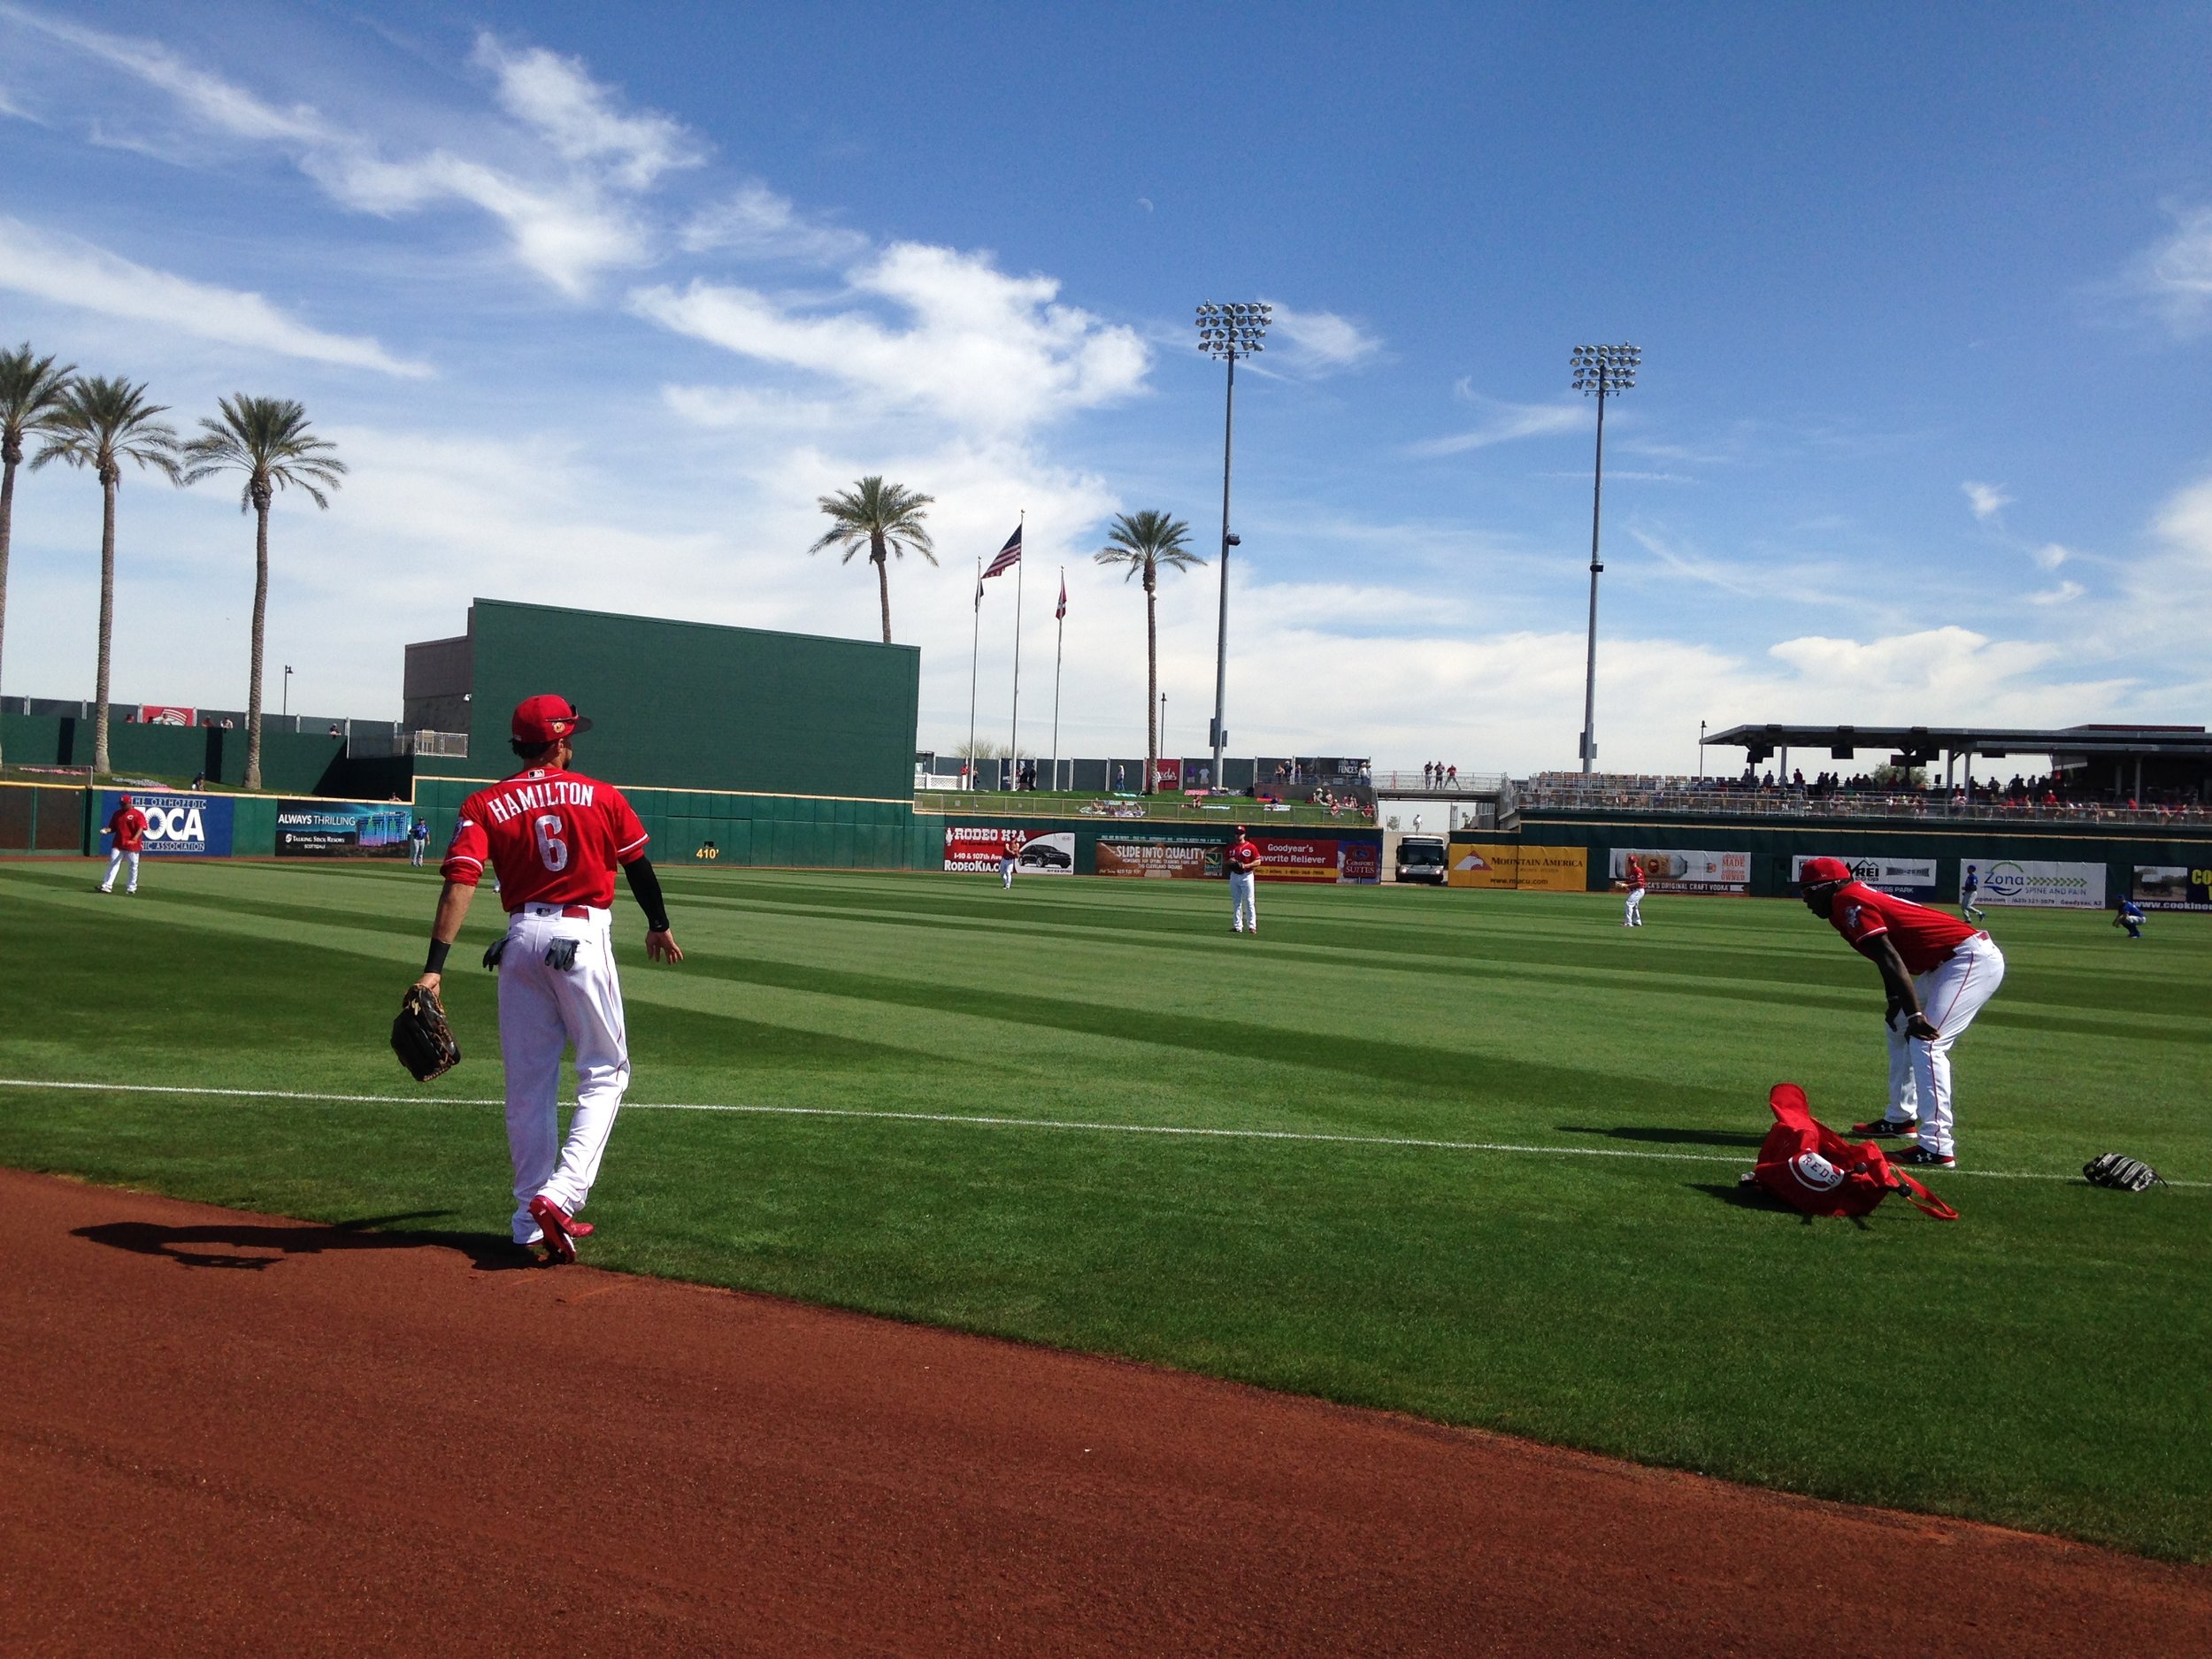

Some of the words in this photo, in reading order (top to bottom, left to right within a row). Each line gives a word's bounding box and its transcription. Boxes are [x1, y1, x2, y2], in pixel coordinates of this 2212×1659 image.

[151, 798, 207, 809] ORTHOPEDIC
[488, 781, 594, 824] HAMILTON
[134, 806, 205, 841] OCA
[278, 813, 312, 825] ALWAYS
[313, 815, 356, 826] THRILLING
[955, 827, 998, 841] RODEO
[156, 841, 205, 850] ASSOCIATION
[534, 814, 568, 872] 6
[1267, 843, 1314, 853] Goodyear's
[1116, 845, 1141, 858] SLIDE
[1142, 846, 1164, 859] INTO
[1165, 848, 1205, 860] QUALITY
[1290, 855, 1326, 864] Reliever
[1491, 856, 1540, 866] MOUNTAIN
[1542, 858, 1584, 867] AMERICA
[1722, 858, 1745, 867] MADE
[1345, 865, 1375, 874] SUITES
[1855, 868, 1879, 878] REI
[1985, 871, 2024, 886] Zona
[1802, 1156, 1839, 1185] REDS
